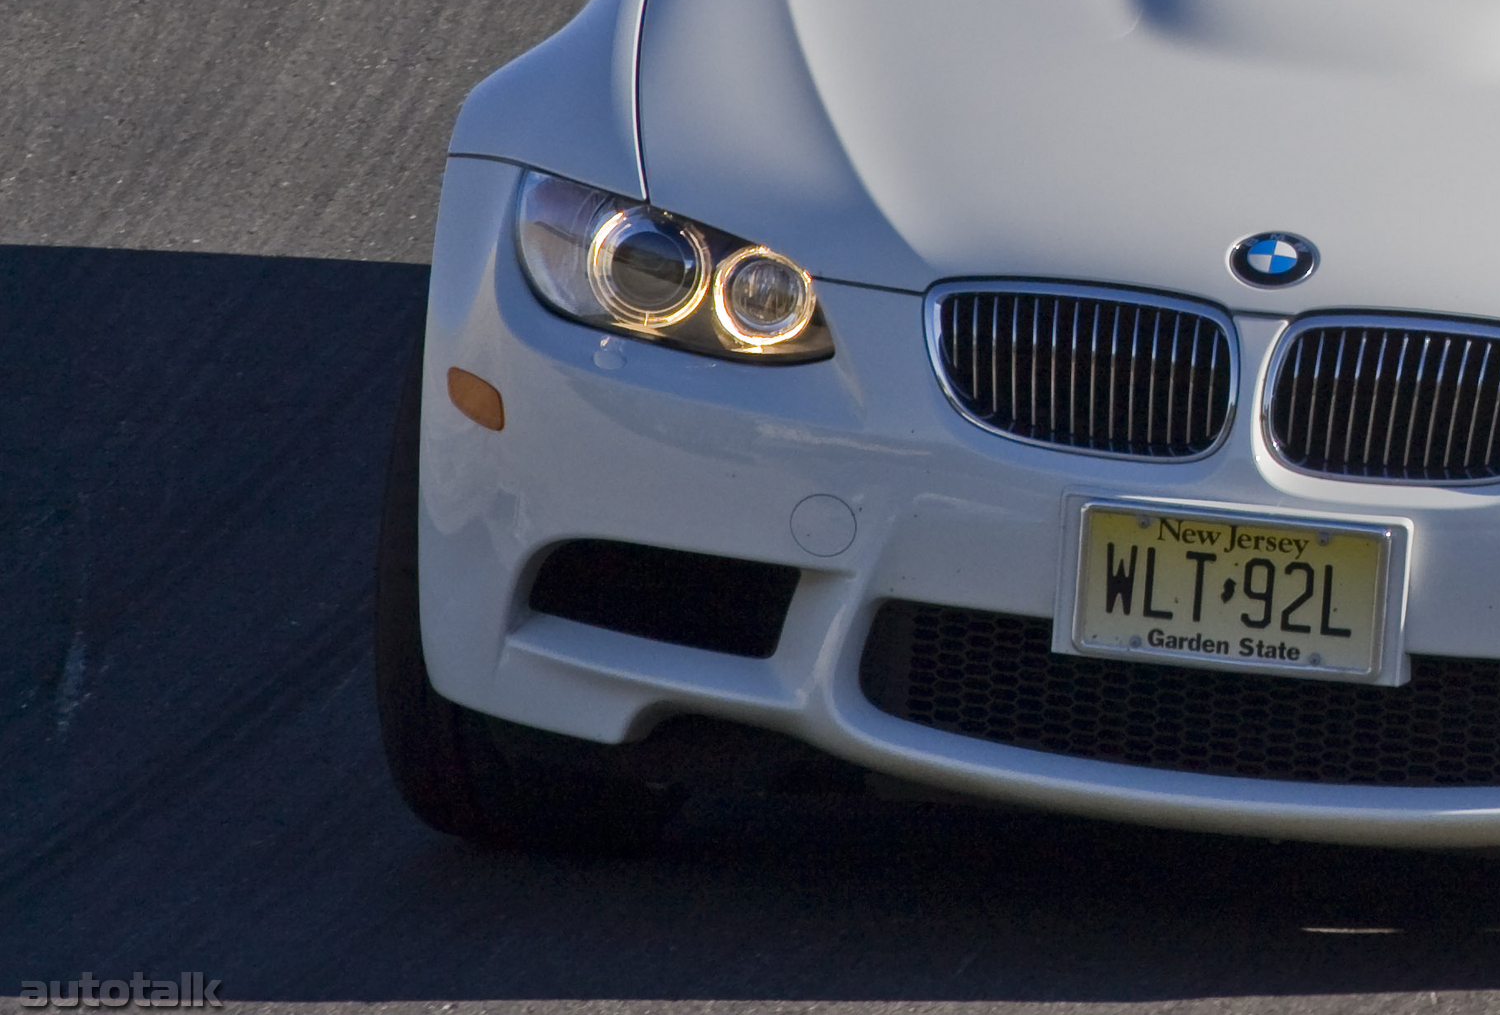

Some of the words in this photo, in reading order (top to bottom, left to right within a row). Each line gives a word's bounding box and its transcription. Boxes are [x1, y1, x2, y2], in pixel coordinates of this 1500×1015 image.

[1157, 518, 1221, 546] New
[1223, 525, 1311, 559] Jersey
[1147, 628, 1230, 655] Garden
[1238, 637, 1301, 662] State
